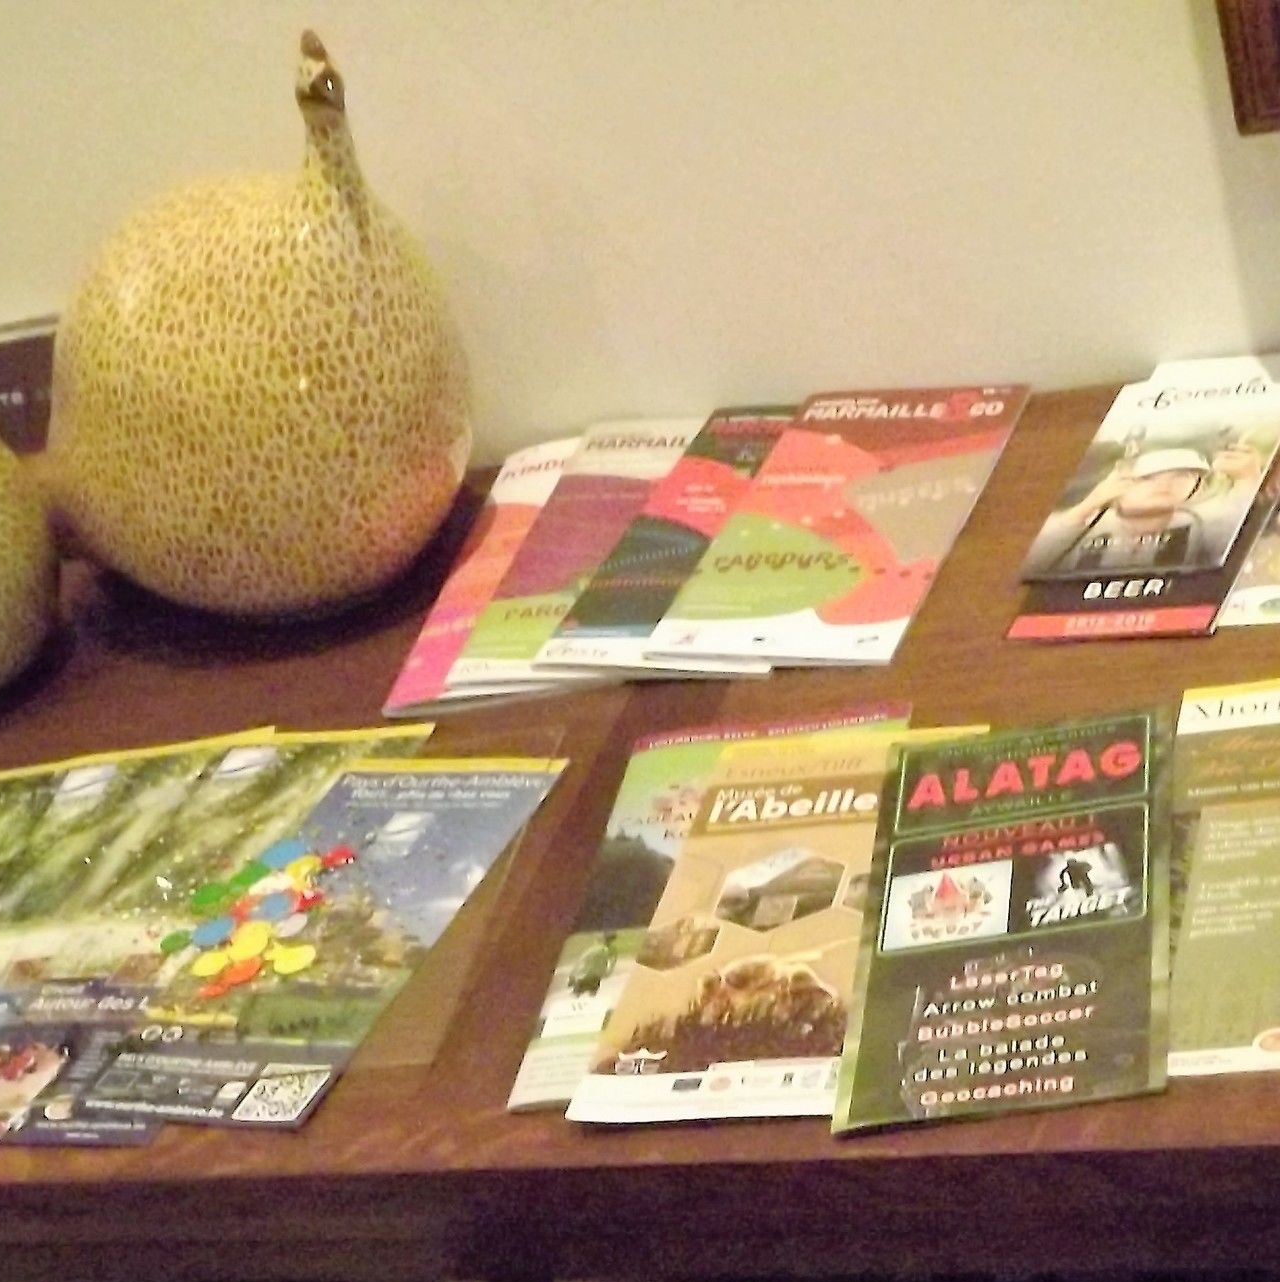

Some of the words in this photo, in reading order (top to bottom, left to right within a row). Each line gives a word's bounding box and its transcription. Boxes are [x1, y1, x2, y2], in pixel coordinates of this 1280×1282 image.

[906, 738, 1142, 811] ALATAG
[708, 788, 879, 824] l'Abeille
[717, 784, 776, 801] Musée
[780, 783, 804, 797] de
[950, 963, 1064, 991] LaserTag
[924, 997, 996, 1018] Arrow
[1007, 980, 1097, 1006] combat
[917, 1005, 1095, 1042] BubbleSoccer
[938, 1049, 968, 1063] La
[979, 1034, 1065, 1057] balade
[914, 1067, 958, 1082] des
[920, 1075, 1074, 1106] Geocaching
